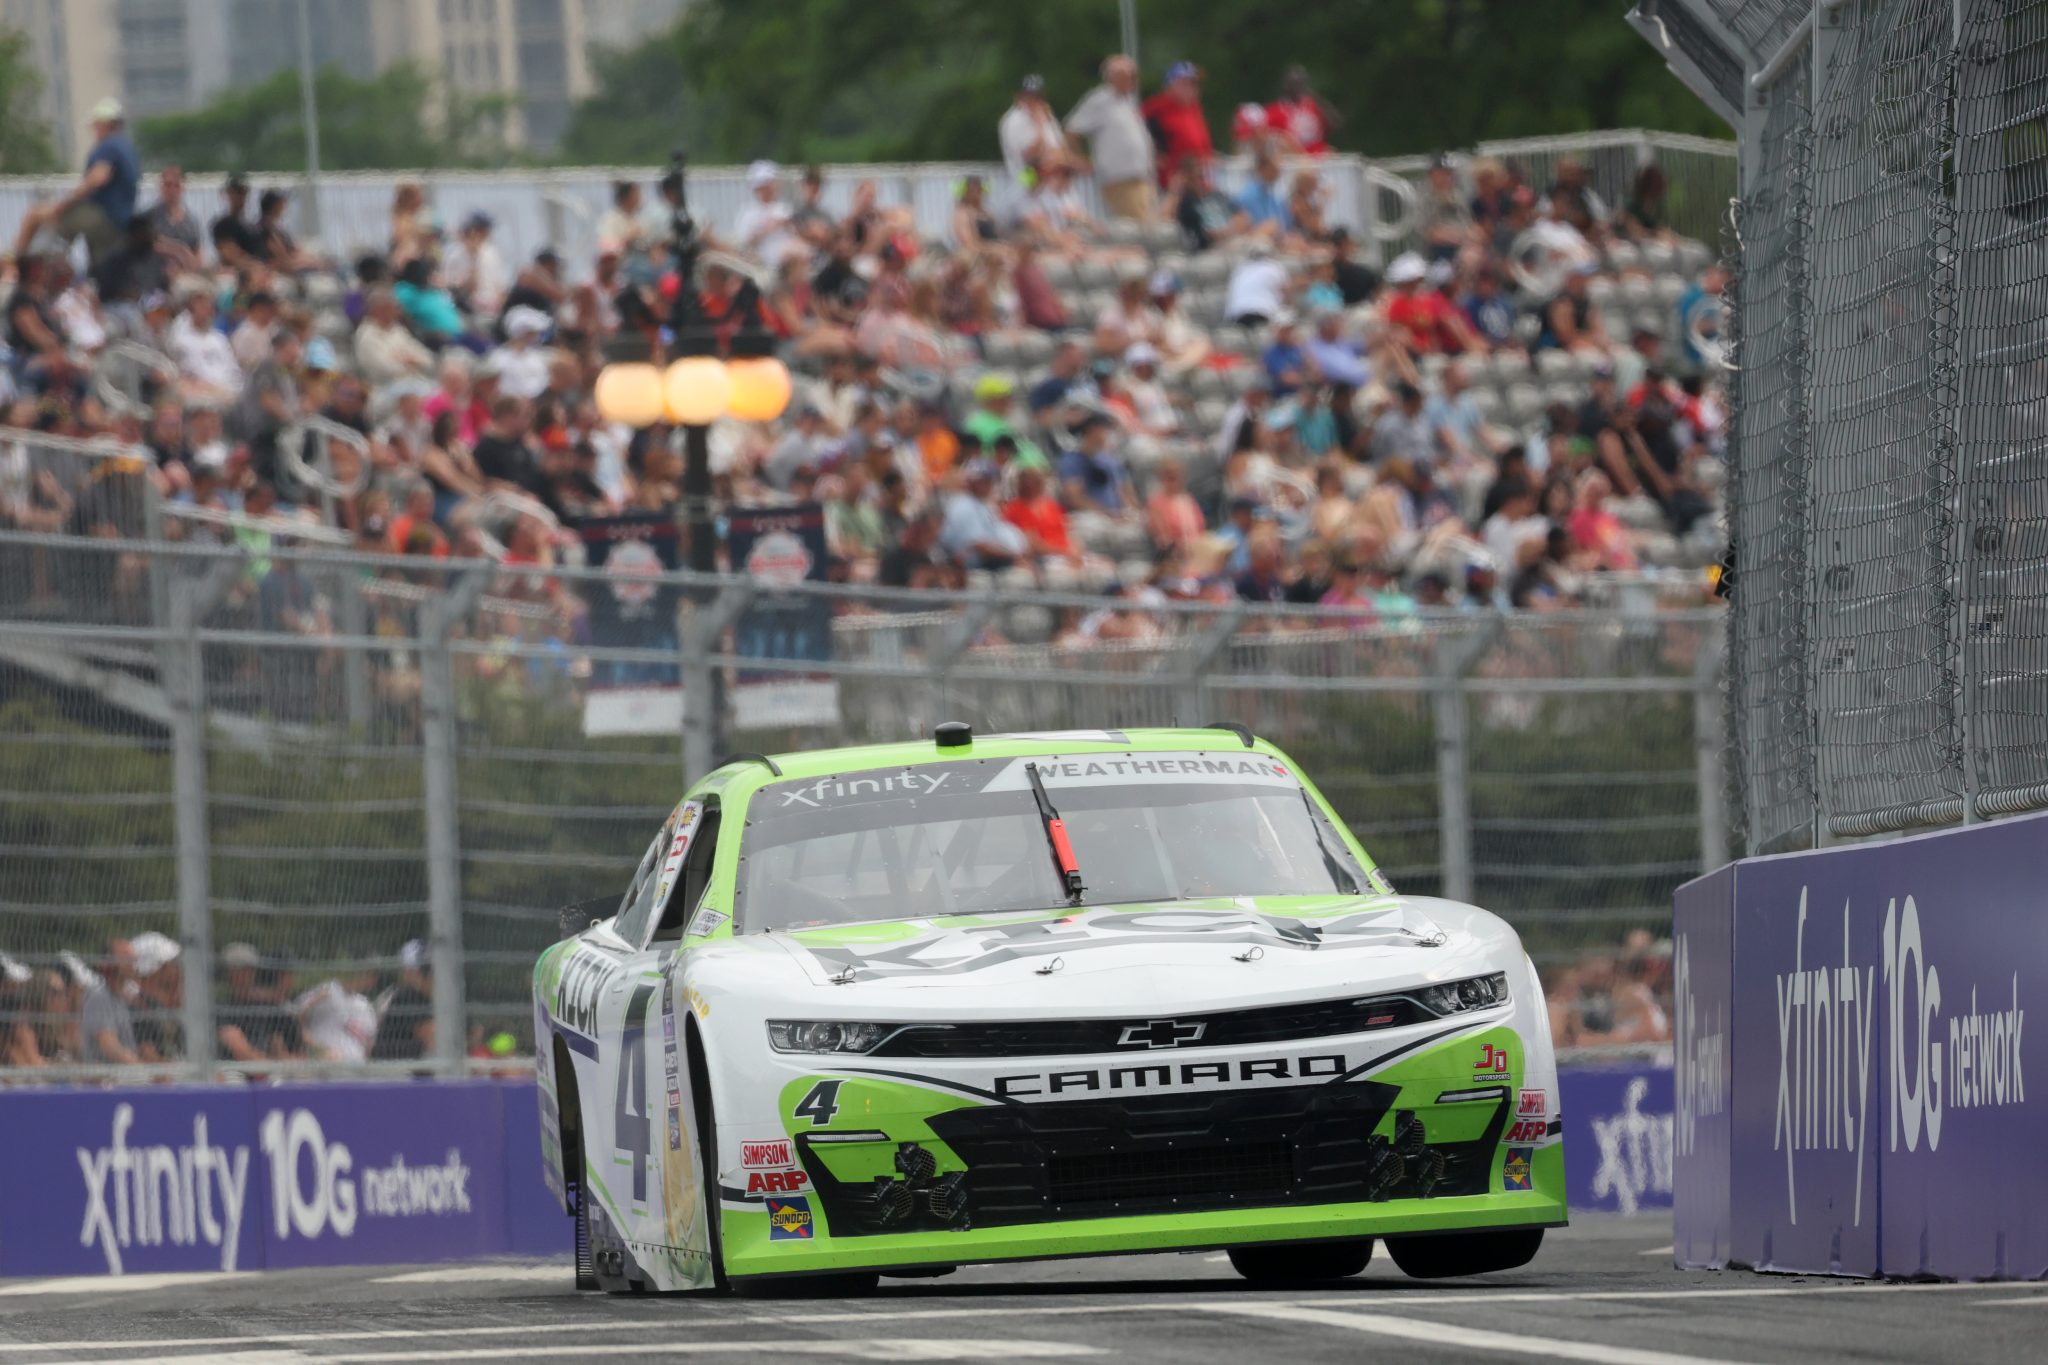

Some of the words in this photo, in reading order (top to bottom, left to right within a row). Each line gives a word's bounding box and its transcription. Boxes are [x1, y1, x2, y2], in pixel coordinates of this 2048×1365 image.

[1036, 759, 1286, 779] WEATHERMAN
[782, 771, 951, 808] xfinity
[556, 949, 618, 1039] KICK
[994, 1054, 1347, 1097] CAMARO
[1775, 885, 1874, 1228] xfinity
[1883, 894, 1942, 1154] 10G
[1949, 970, 2025, 1109] network
[794, 1079, 849, 1125] 4
[743, 1143, 790, 1167] SIMPSON
[77, 1103, 249, 1275] xfinity
[260, 1107, 357, 1240] 10G
[363, 1148, 471, 1216] network
[747, 1170, 809, 1193] ARP
[772, 1212, 810, 1226] SUNOCO
